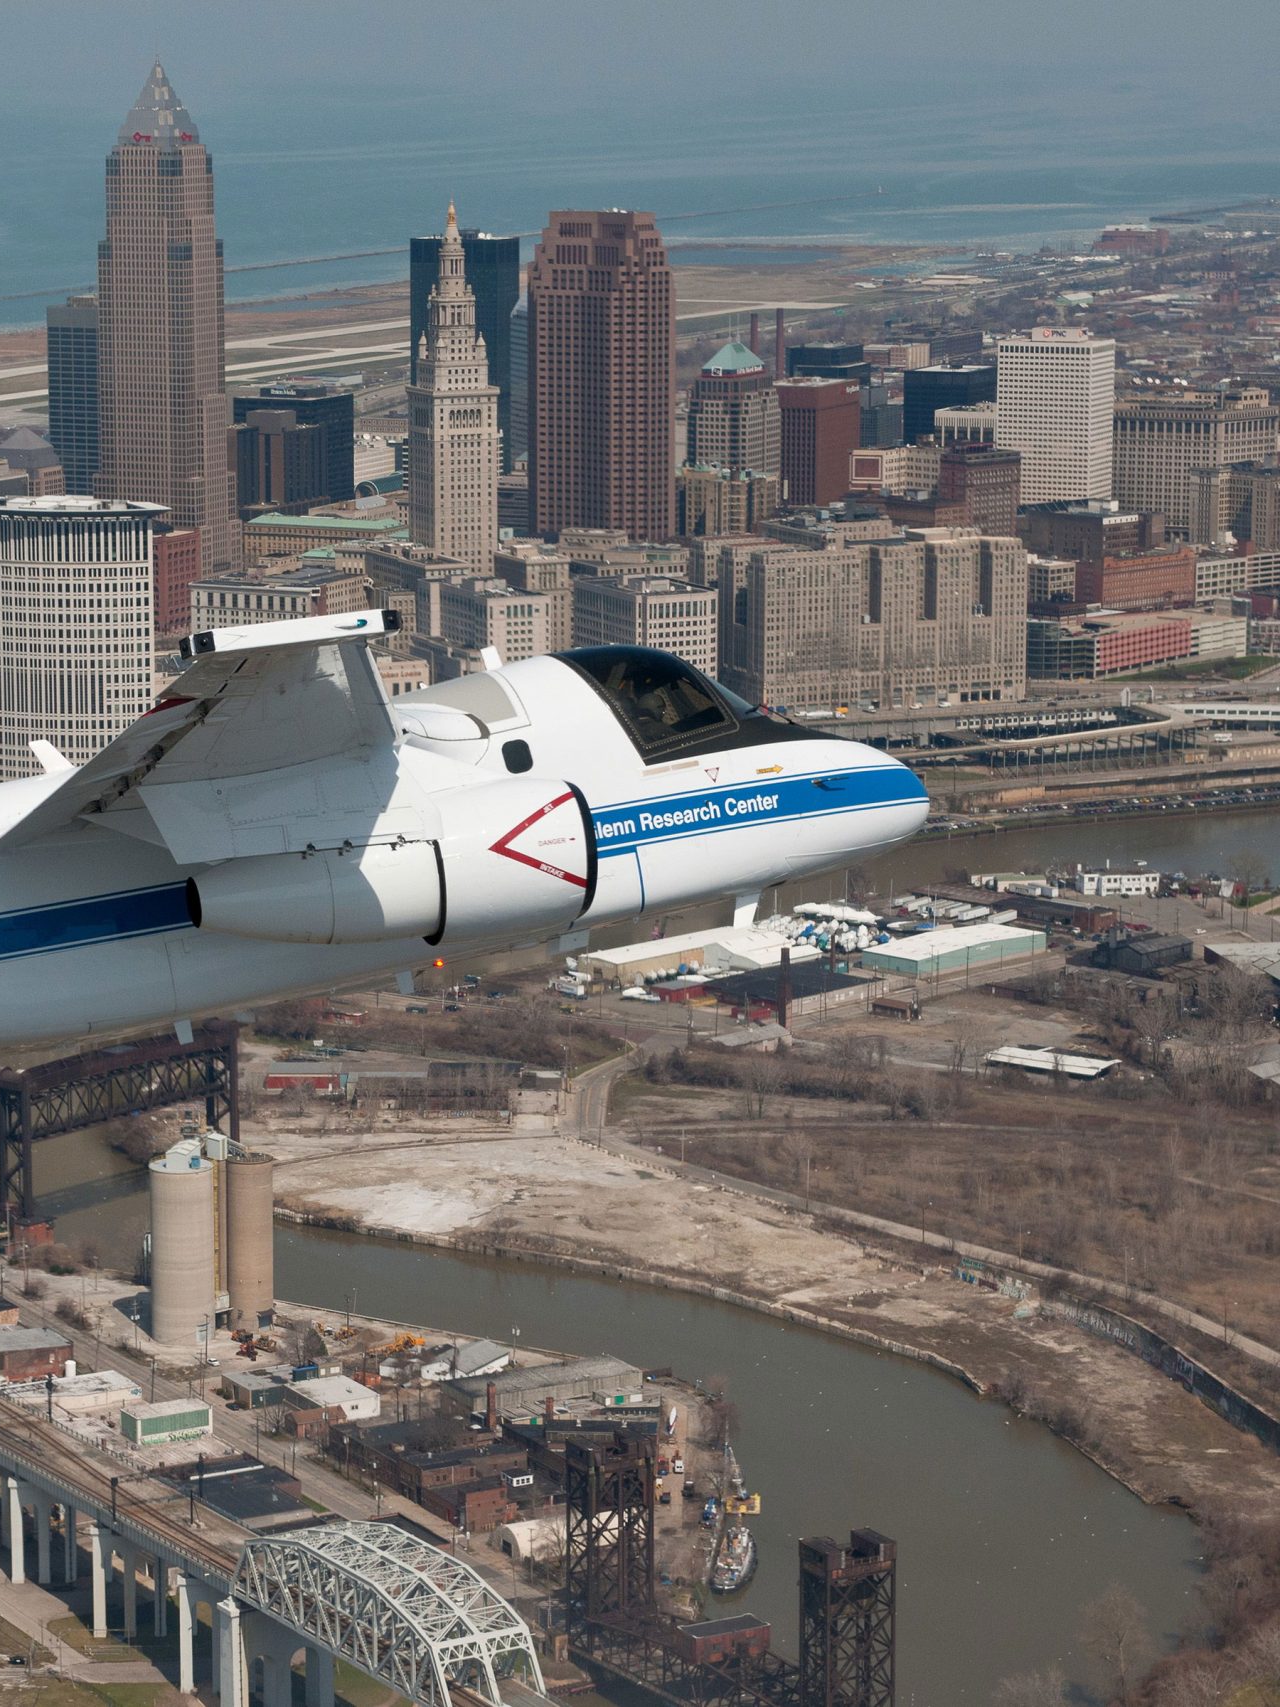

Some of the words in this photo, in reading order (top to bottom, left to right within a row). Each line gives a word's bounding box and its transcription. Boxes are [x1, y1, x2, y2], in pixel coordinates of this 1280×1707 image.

[543, 804, 554, 813] JET
[639, 800, 721, 832] Research
[724, 793, 780, 817] Center
[538, 837, 566, 847] DANGER
[540, 863, 565, 878] INTAKE
